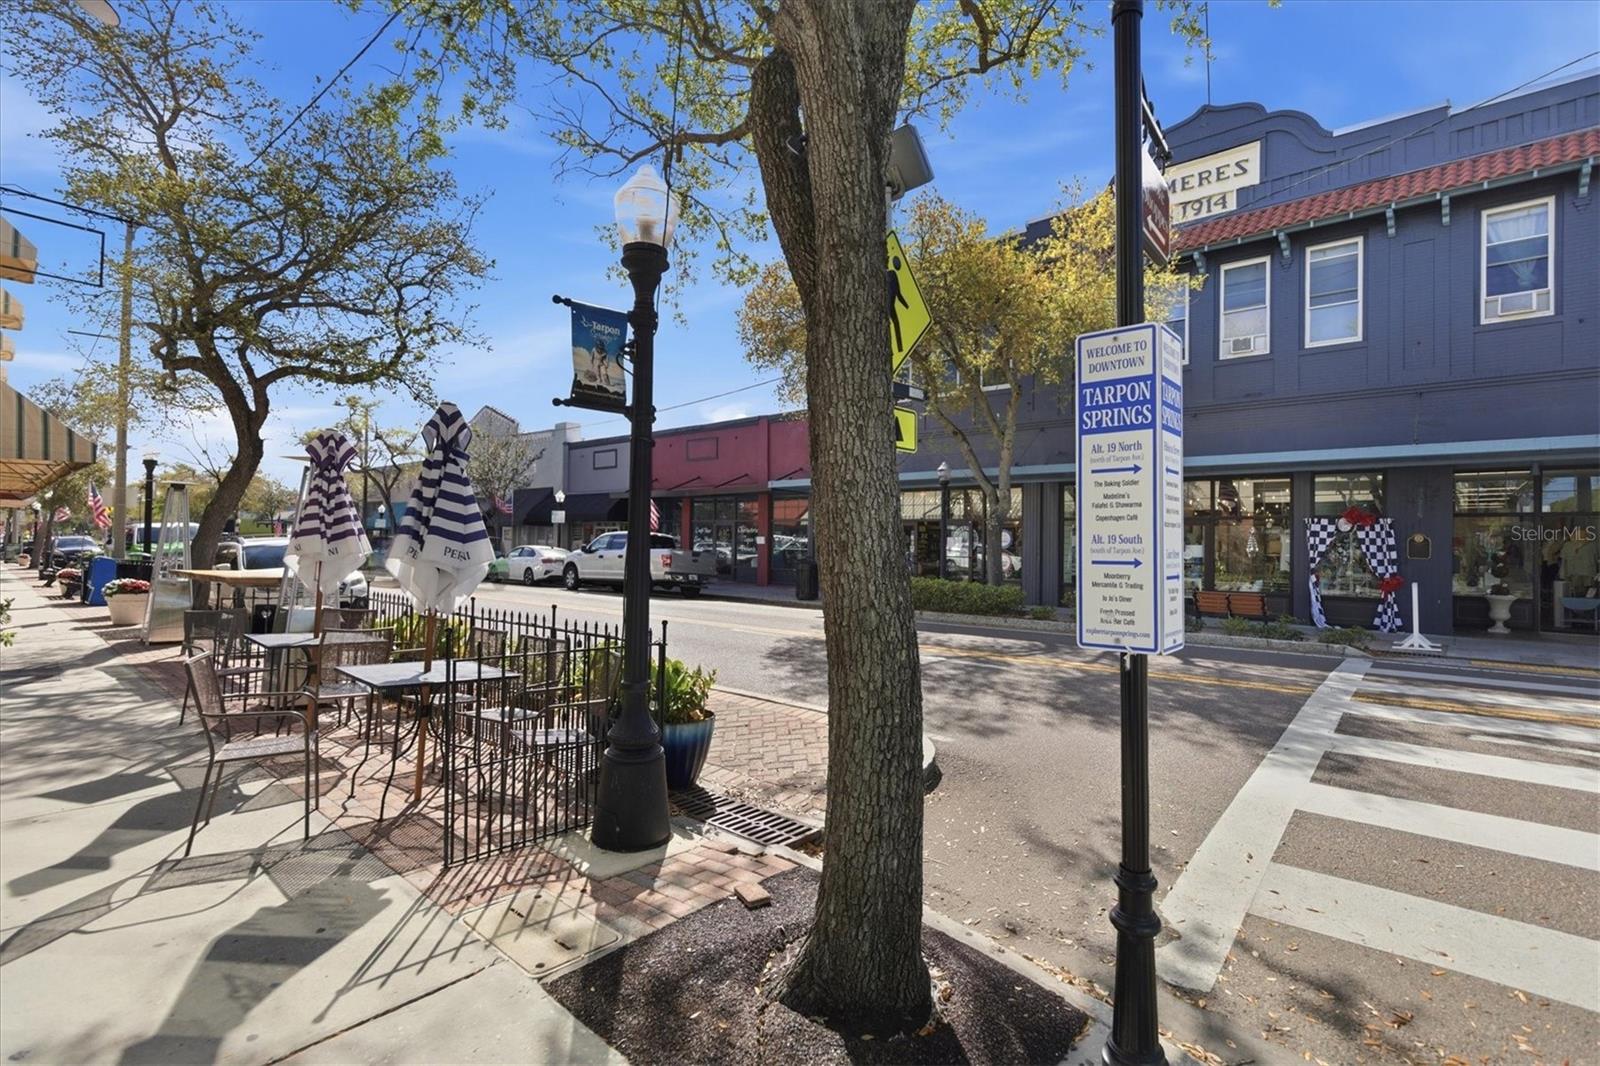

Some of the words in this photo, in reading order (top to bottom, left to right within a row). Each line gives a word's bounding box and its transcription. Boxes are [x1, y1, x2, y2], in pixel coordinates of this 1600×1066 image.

[1167, 158, 1249, 194] MERES
[1179, 193, 1228, 219] 1914
[592, 320, 620, 336] Tarpon
[1086, 342, 1132, 359] WELCOME
[1133, 340, 1148, 351] TO
[1088, 355, 1145, 374] DOWNTOWN
[1083, 380, 1152, 407] TARPON
[1083, 404, 1152, 430] SPRINGS
[1091, 443, 1104, 454] Alt.
[1107, 442, 1117, 453] 19
[1118, 440, 1143, 452] North
[1104, 480, 1121, 488] Baking
[1122, 479, 1140, 487] Soldier
[1091, 534, 1104, 545] Alt.
[1107, 534, 1117, 545] 19
[1118, 534, 1143, 545] South
